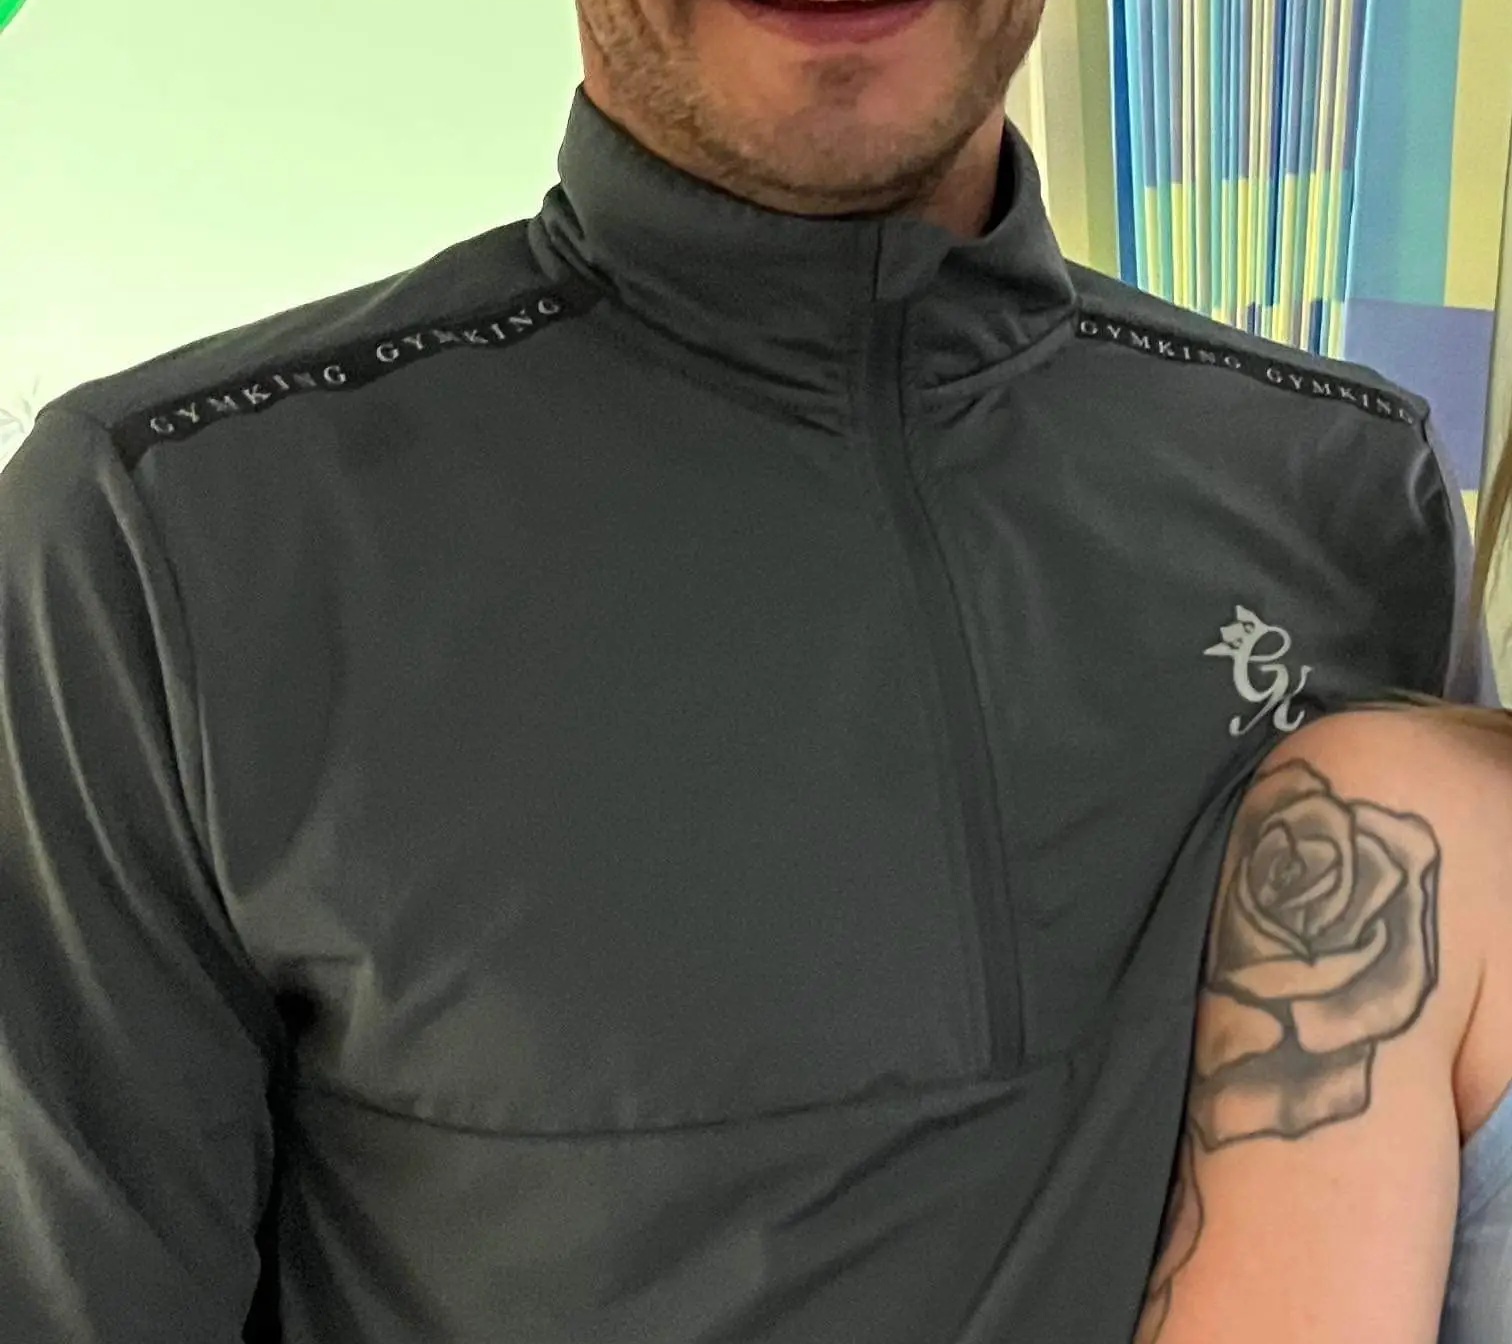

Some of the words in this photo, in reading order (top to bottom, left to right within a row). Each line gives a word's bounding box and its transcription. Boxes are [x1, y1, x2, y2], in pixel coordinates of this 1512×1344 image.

[149, 364, 348, 436] GYMKING
[375, 296, 561, 363] GYMKING
[1079, 319, 1242, 370] GYMKING
